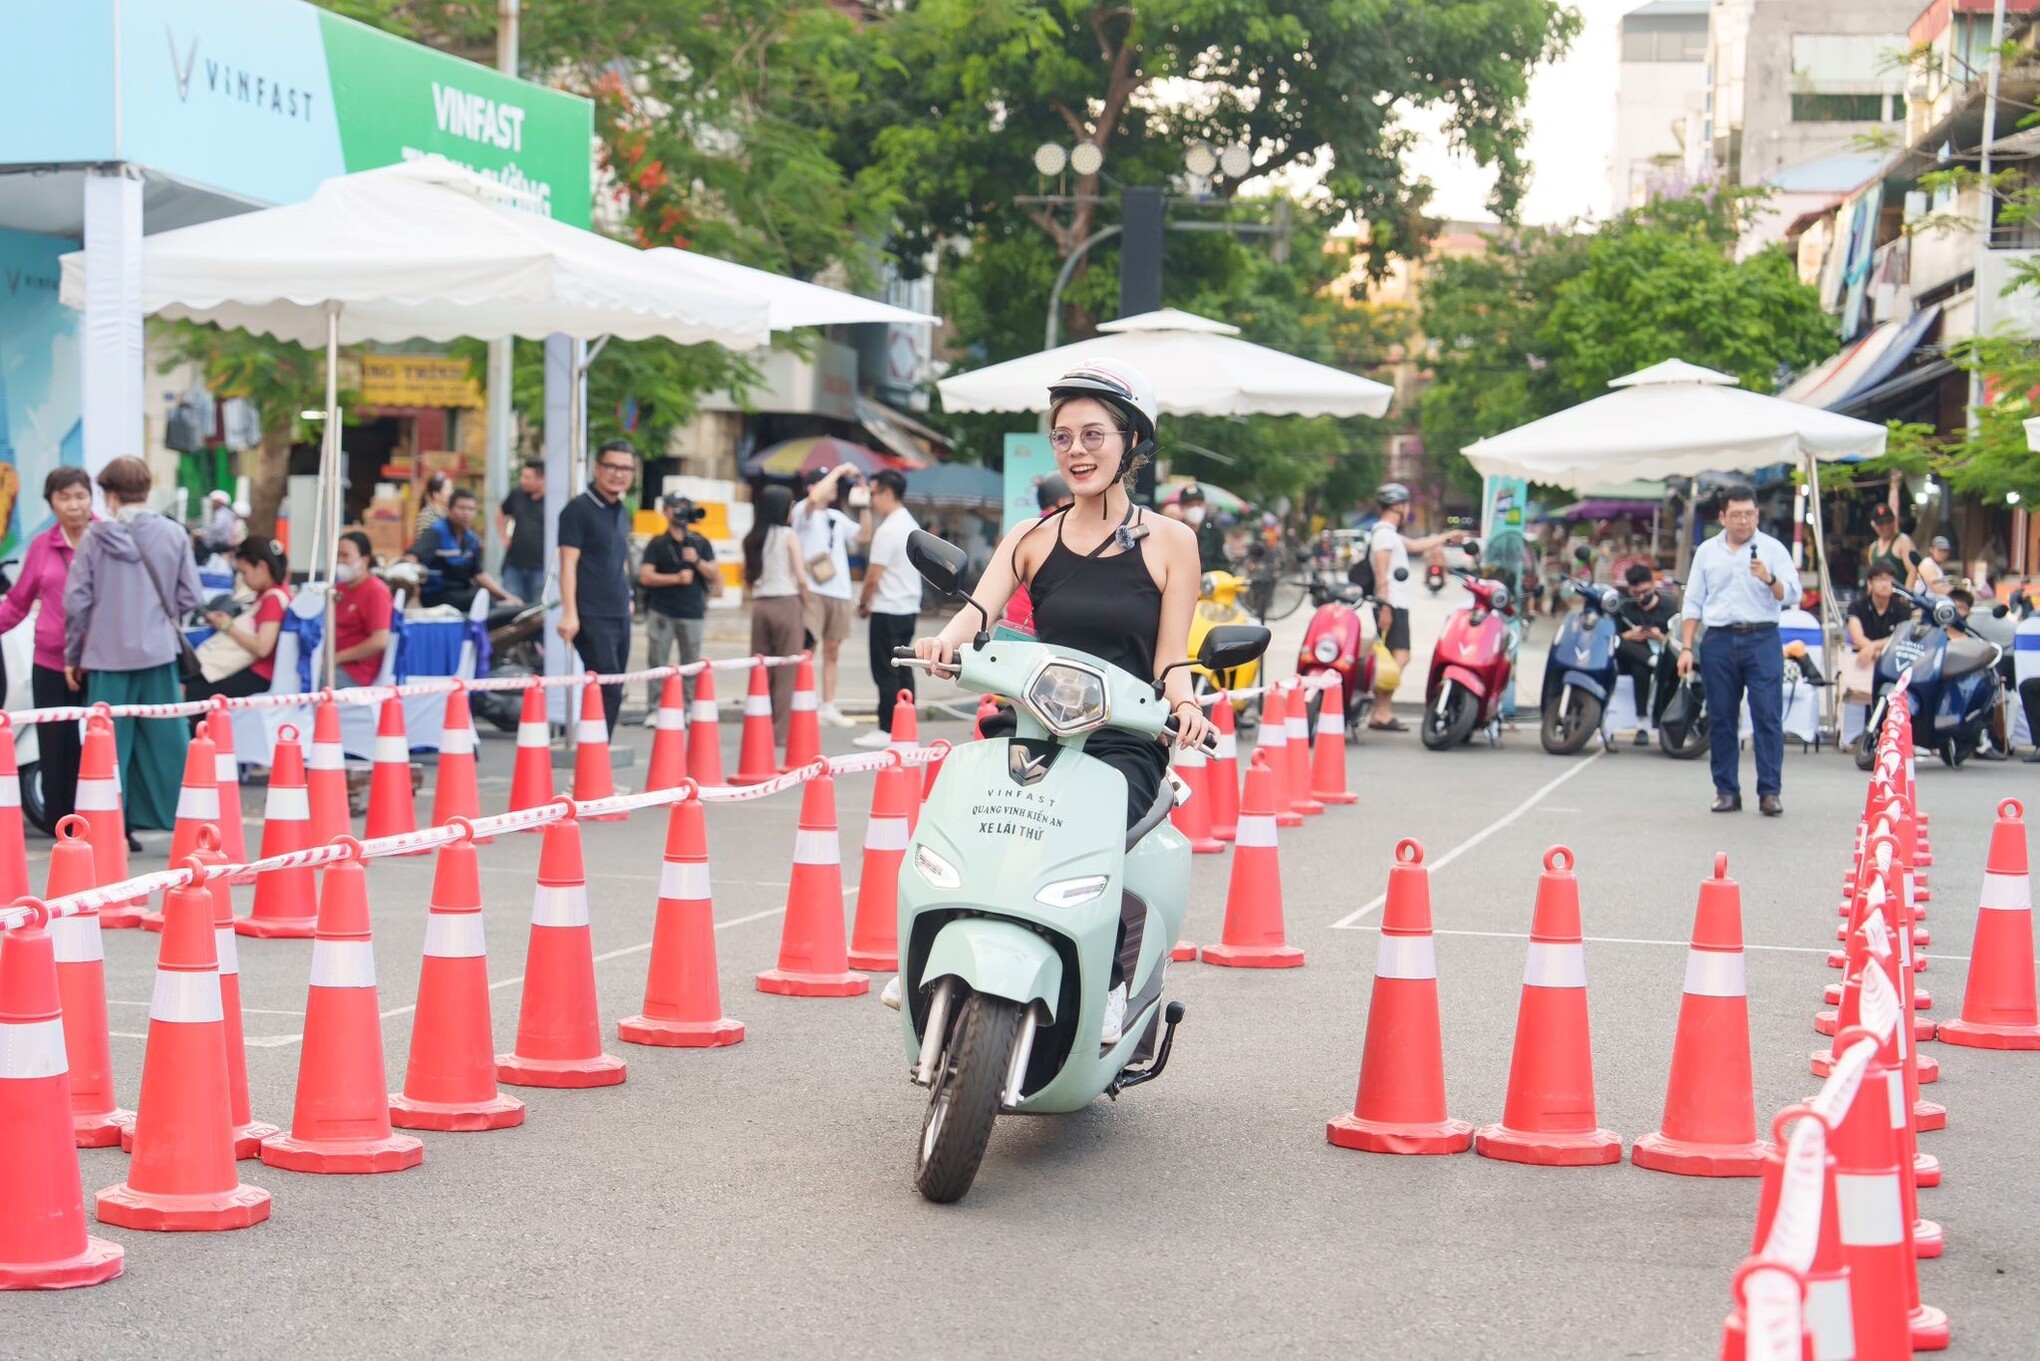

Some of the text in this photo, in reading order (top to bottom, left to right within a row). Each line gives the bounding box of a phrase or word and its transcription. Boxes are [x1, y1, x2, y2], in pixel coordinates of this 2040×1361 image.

[431, 81, 525, 152] VINFAST
[987, 789, 1056, 808] VINFAST
[972, 805, 1002, 815] QUANG
[1004, 806, 1026, 817] VINH
[1049, 816, 1064, 828] AN
[979, 822, 994, 834] XE
[996, 820, 1016, 835] LÁI
